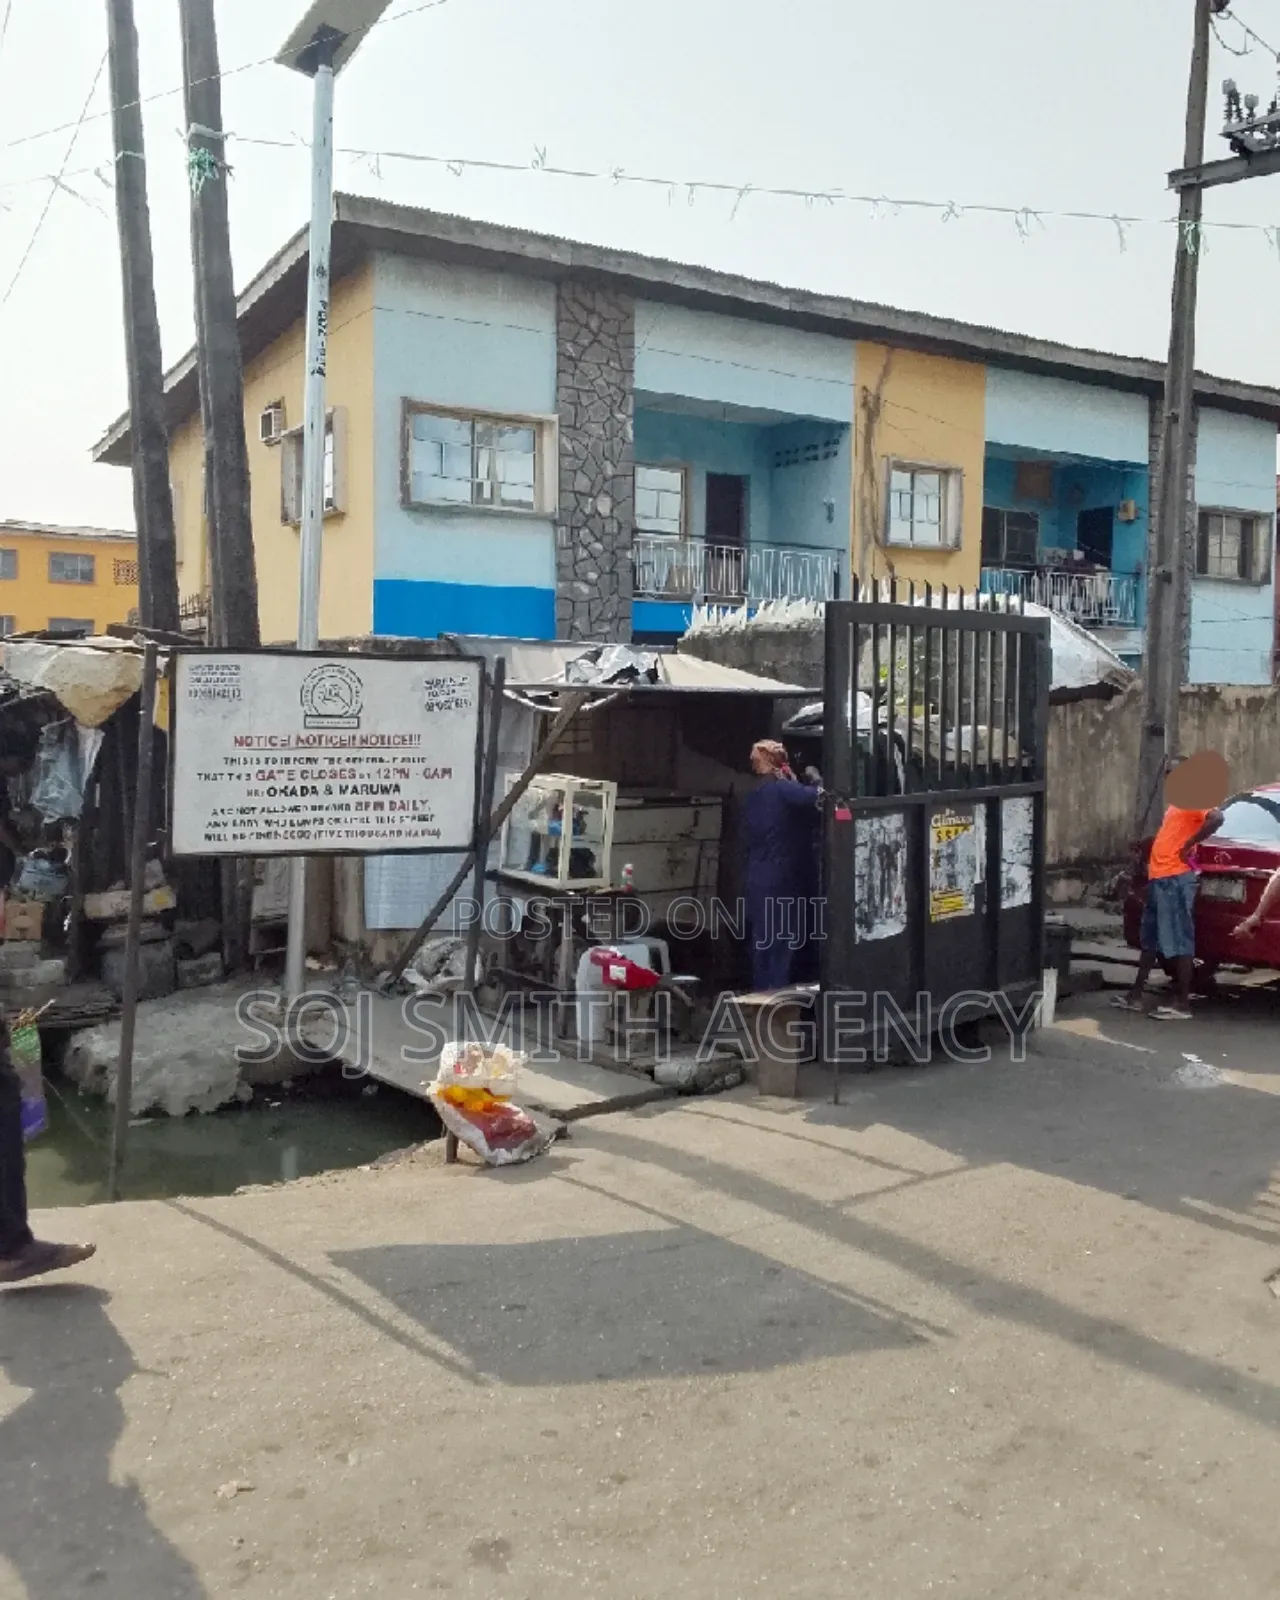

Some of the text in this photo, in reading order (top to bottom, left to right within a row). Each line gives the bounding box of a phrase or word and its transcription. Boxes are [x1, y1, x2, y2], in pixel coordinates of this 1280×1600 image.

[360, 734, 421, 746] NOTICE!!!
[197, 772, 224, 782] THAT
[255, 769, 296, 781] GATE
[300, 768, 357, 780] CLOSES
[376, 768, 410, 780] 12PM
[266, 785, 319, 797] OKADA
[323, 784, 334, 795] &
[339, 784, 401, 795] MARUWA
[236, 806, 257, 815] NOT
